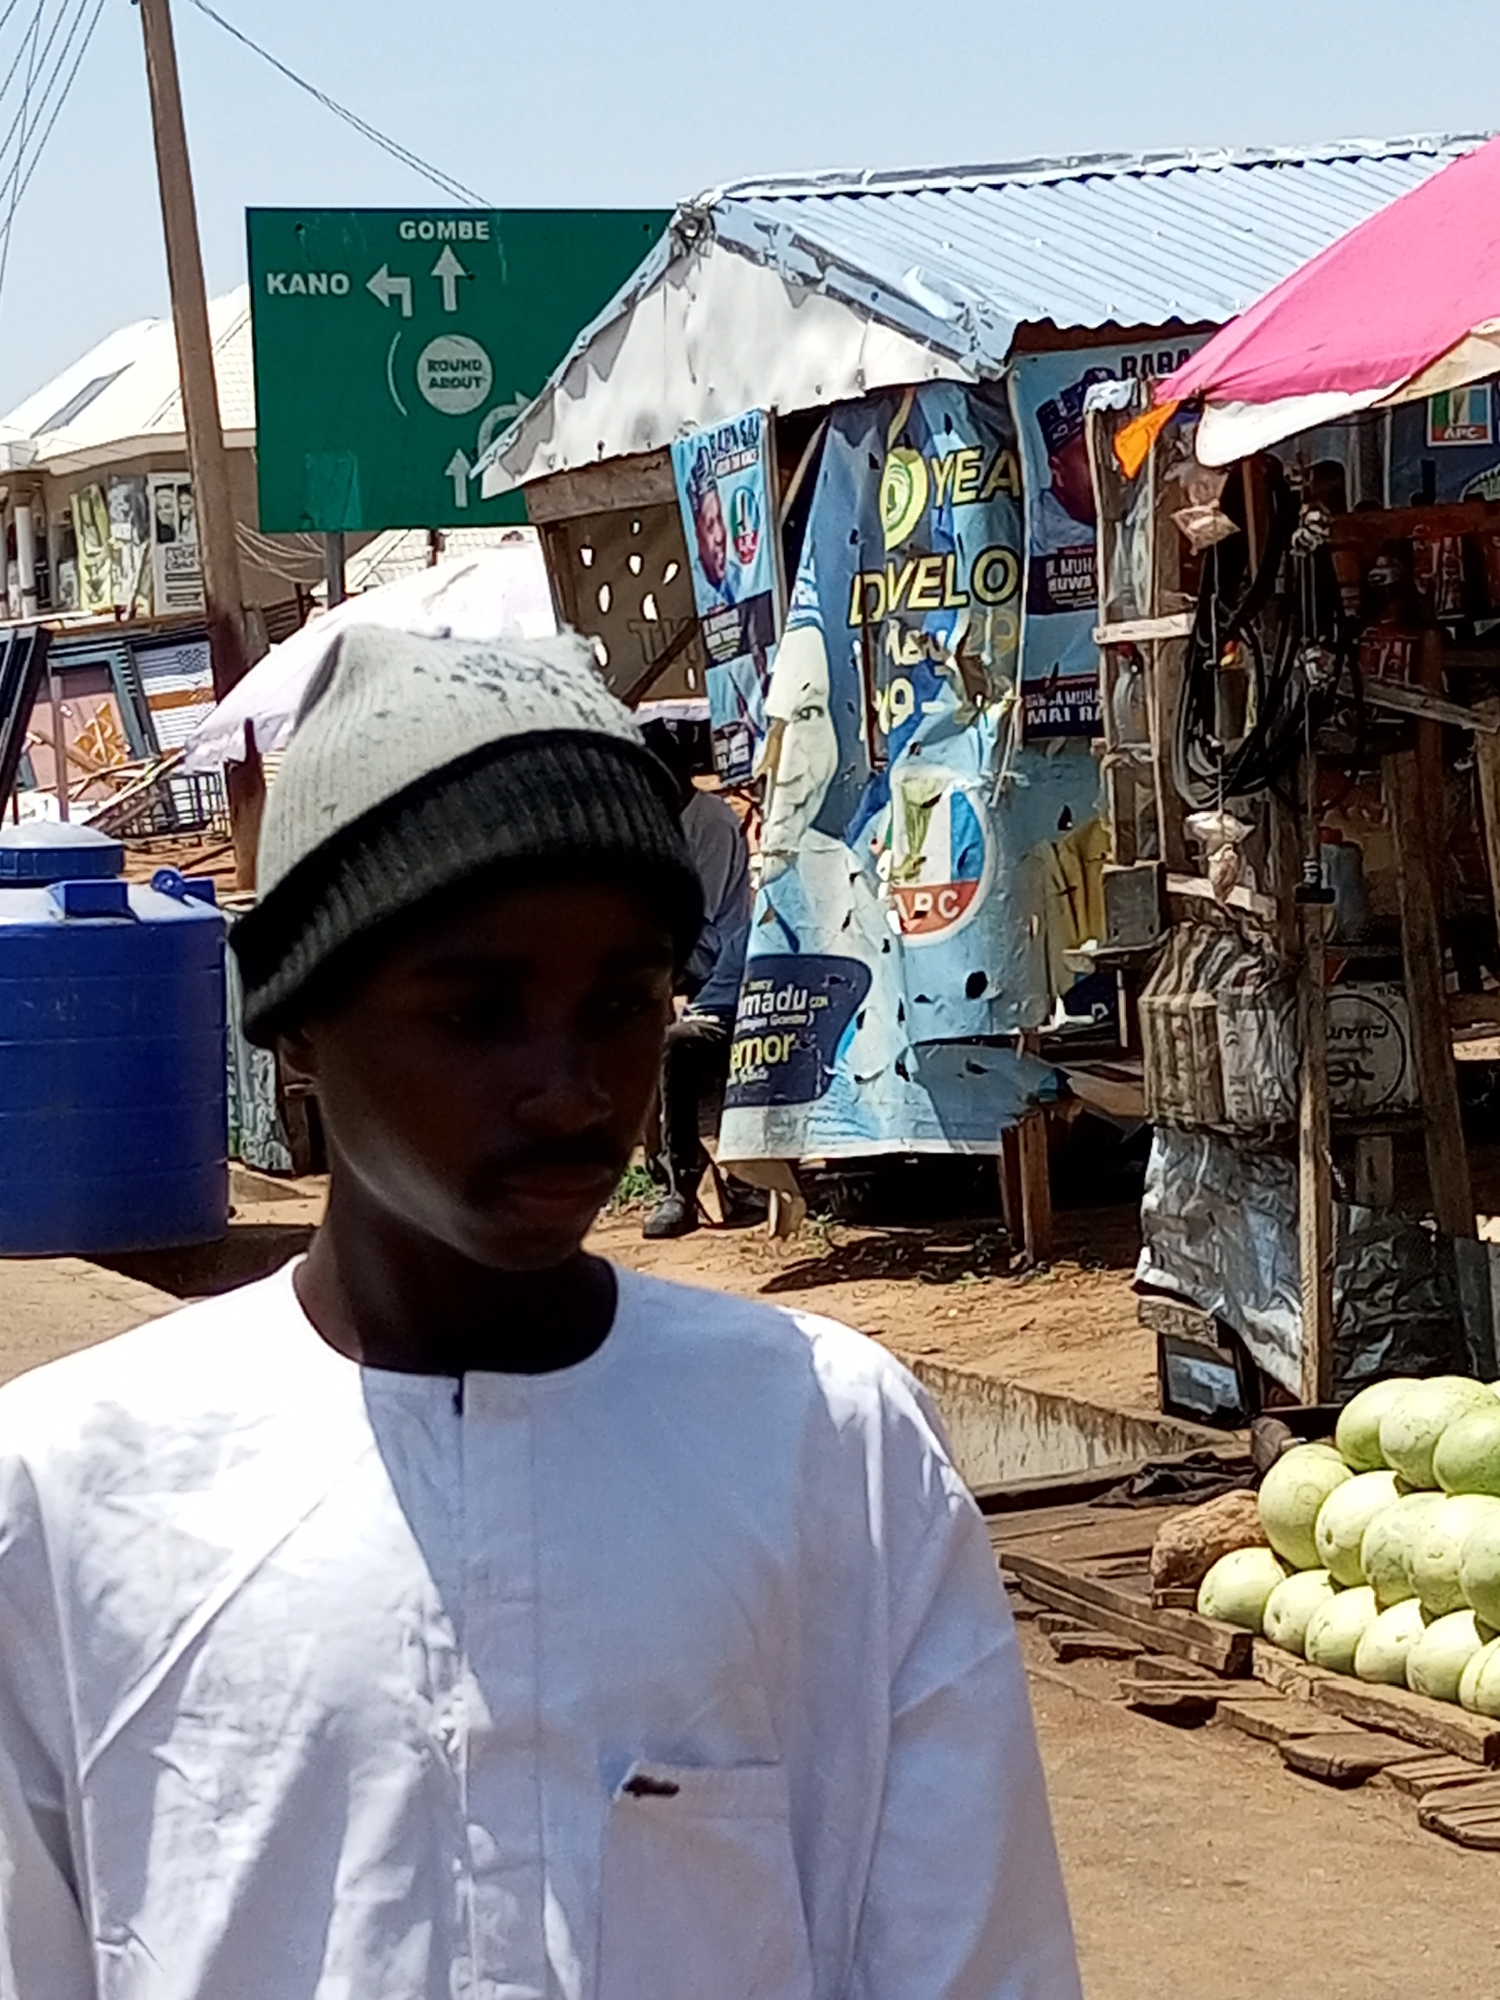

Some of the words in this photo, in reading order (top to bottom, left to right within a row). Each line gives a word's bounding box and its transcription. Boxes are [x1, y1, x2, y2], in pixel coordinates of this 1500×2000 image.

[399, 220, 490, 241] GOMBE
[266, 273, 350, 295] KANO
[427, 359, 483, 373] ROUND
[428, 375, 484, 390] ABOUT
[1444, 426, 1480, 440] APC
